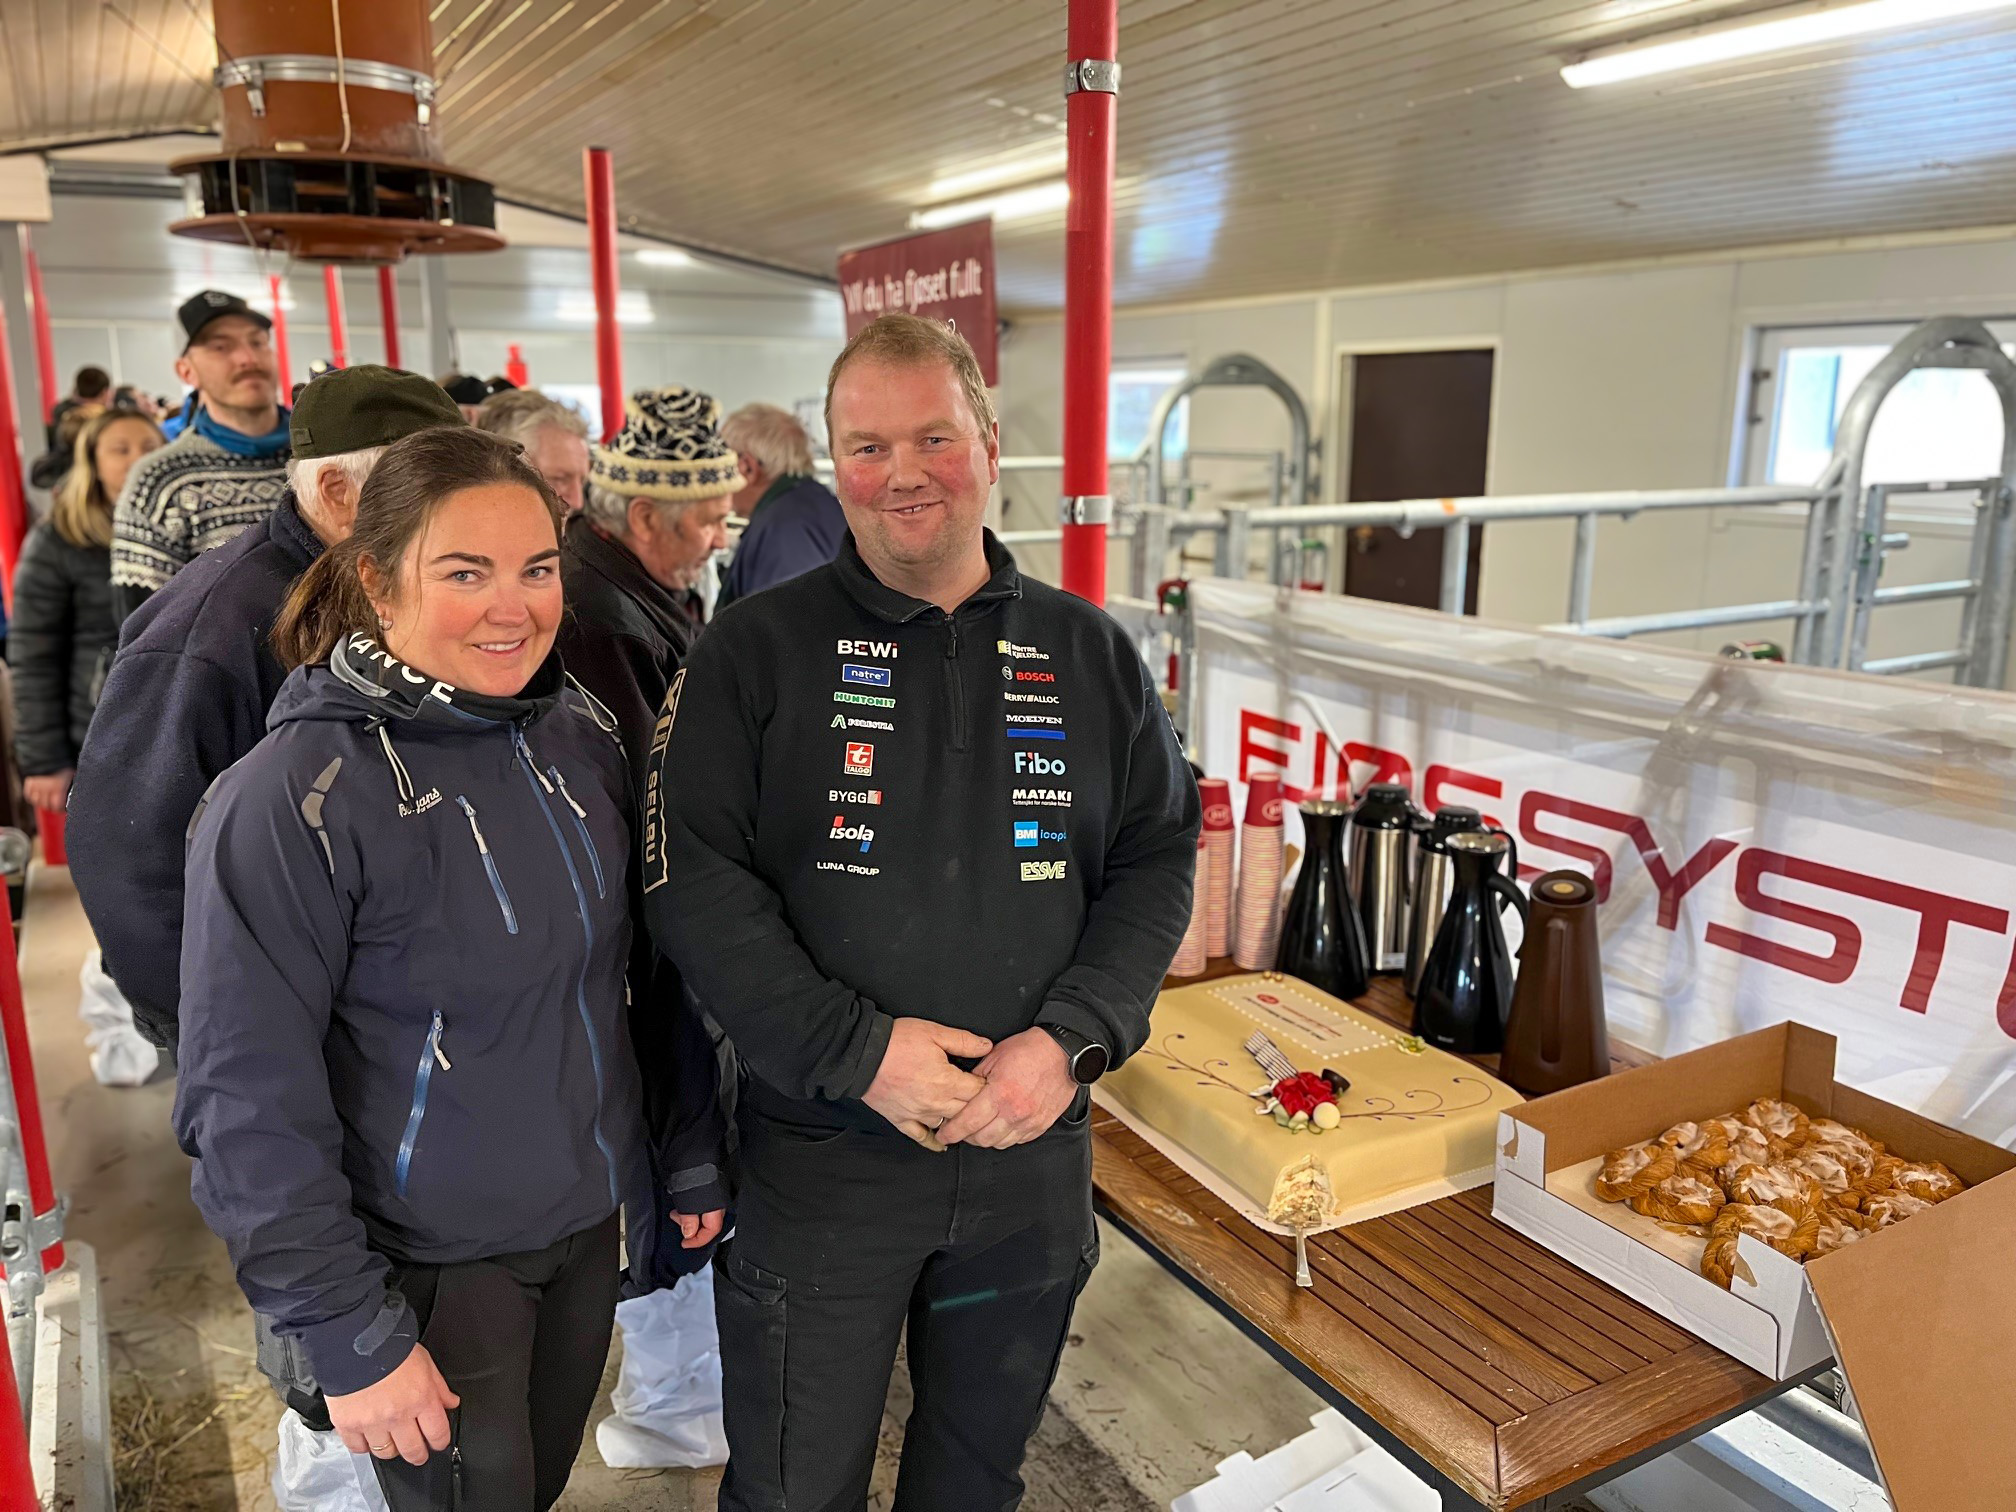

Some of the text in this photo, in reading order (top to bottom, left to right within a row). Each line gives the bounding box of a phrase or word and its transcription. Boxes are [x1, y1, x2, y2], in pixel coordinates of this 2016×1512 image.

[863, 277, 884, 312] du
[1016, 671, 1055, 683] BOSCH
[834, 691, 896, 709] HUNTONIT
[1005, 714, 1063, 725] MOELVEN
[846, 766, 871, 774] TALGO
[1014, 751, 1066, 776] Fibo
[1012, 788, 1072, 802] MATAKI
[645, 769, 658, 864] SELBU
[1015, 829, 1037, 839] BMI
[816, 861, 880, 876] LUNA GROUP
[1020, 860, 1067, 882] ESSVE
[1238, 707, 2016, 1041] FJØSSYST
